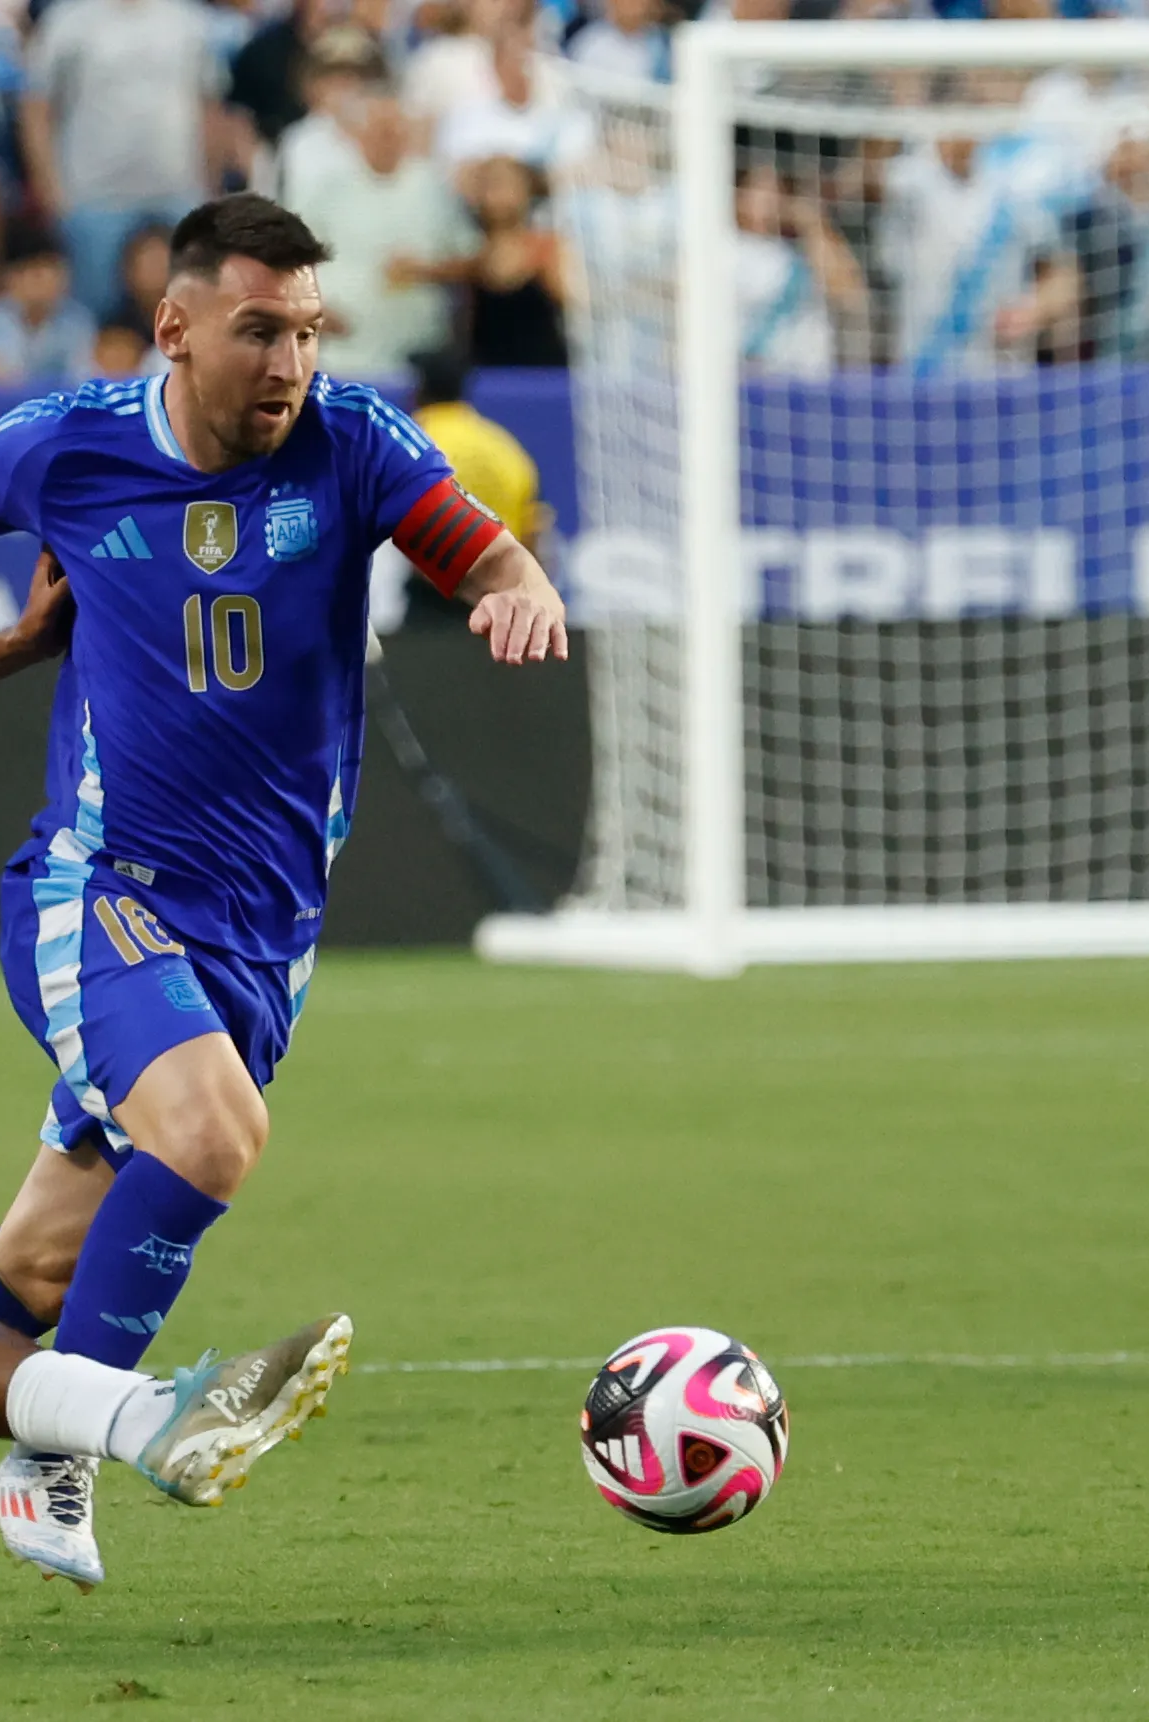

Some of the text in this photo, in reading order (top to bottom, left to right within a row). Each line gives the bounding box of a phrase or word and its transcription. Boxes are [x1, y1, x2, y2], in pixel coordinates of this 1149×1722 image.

[199, 546, 223, 556] FIFA
[183, 594, 265, 692] 10
[205, 1358, 268, 1423] PARLEY
